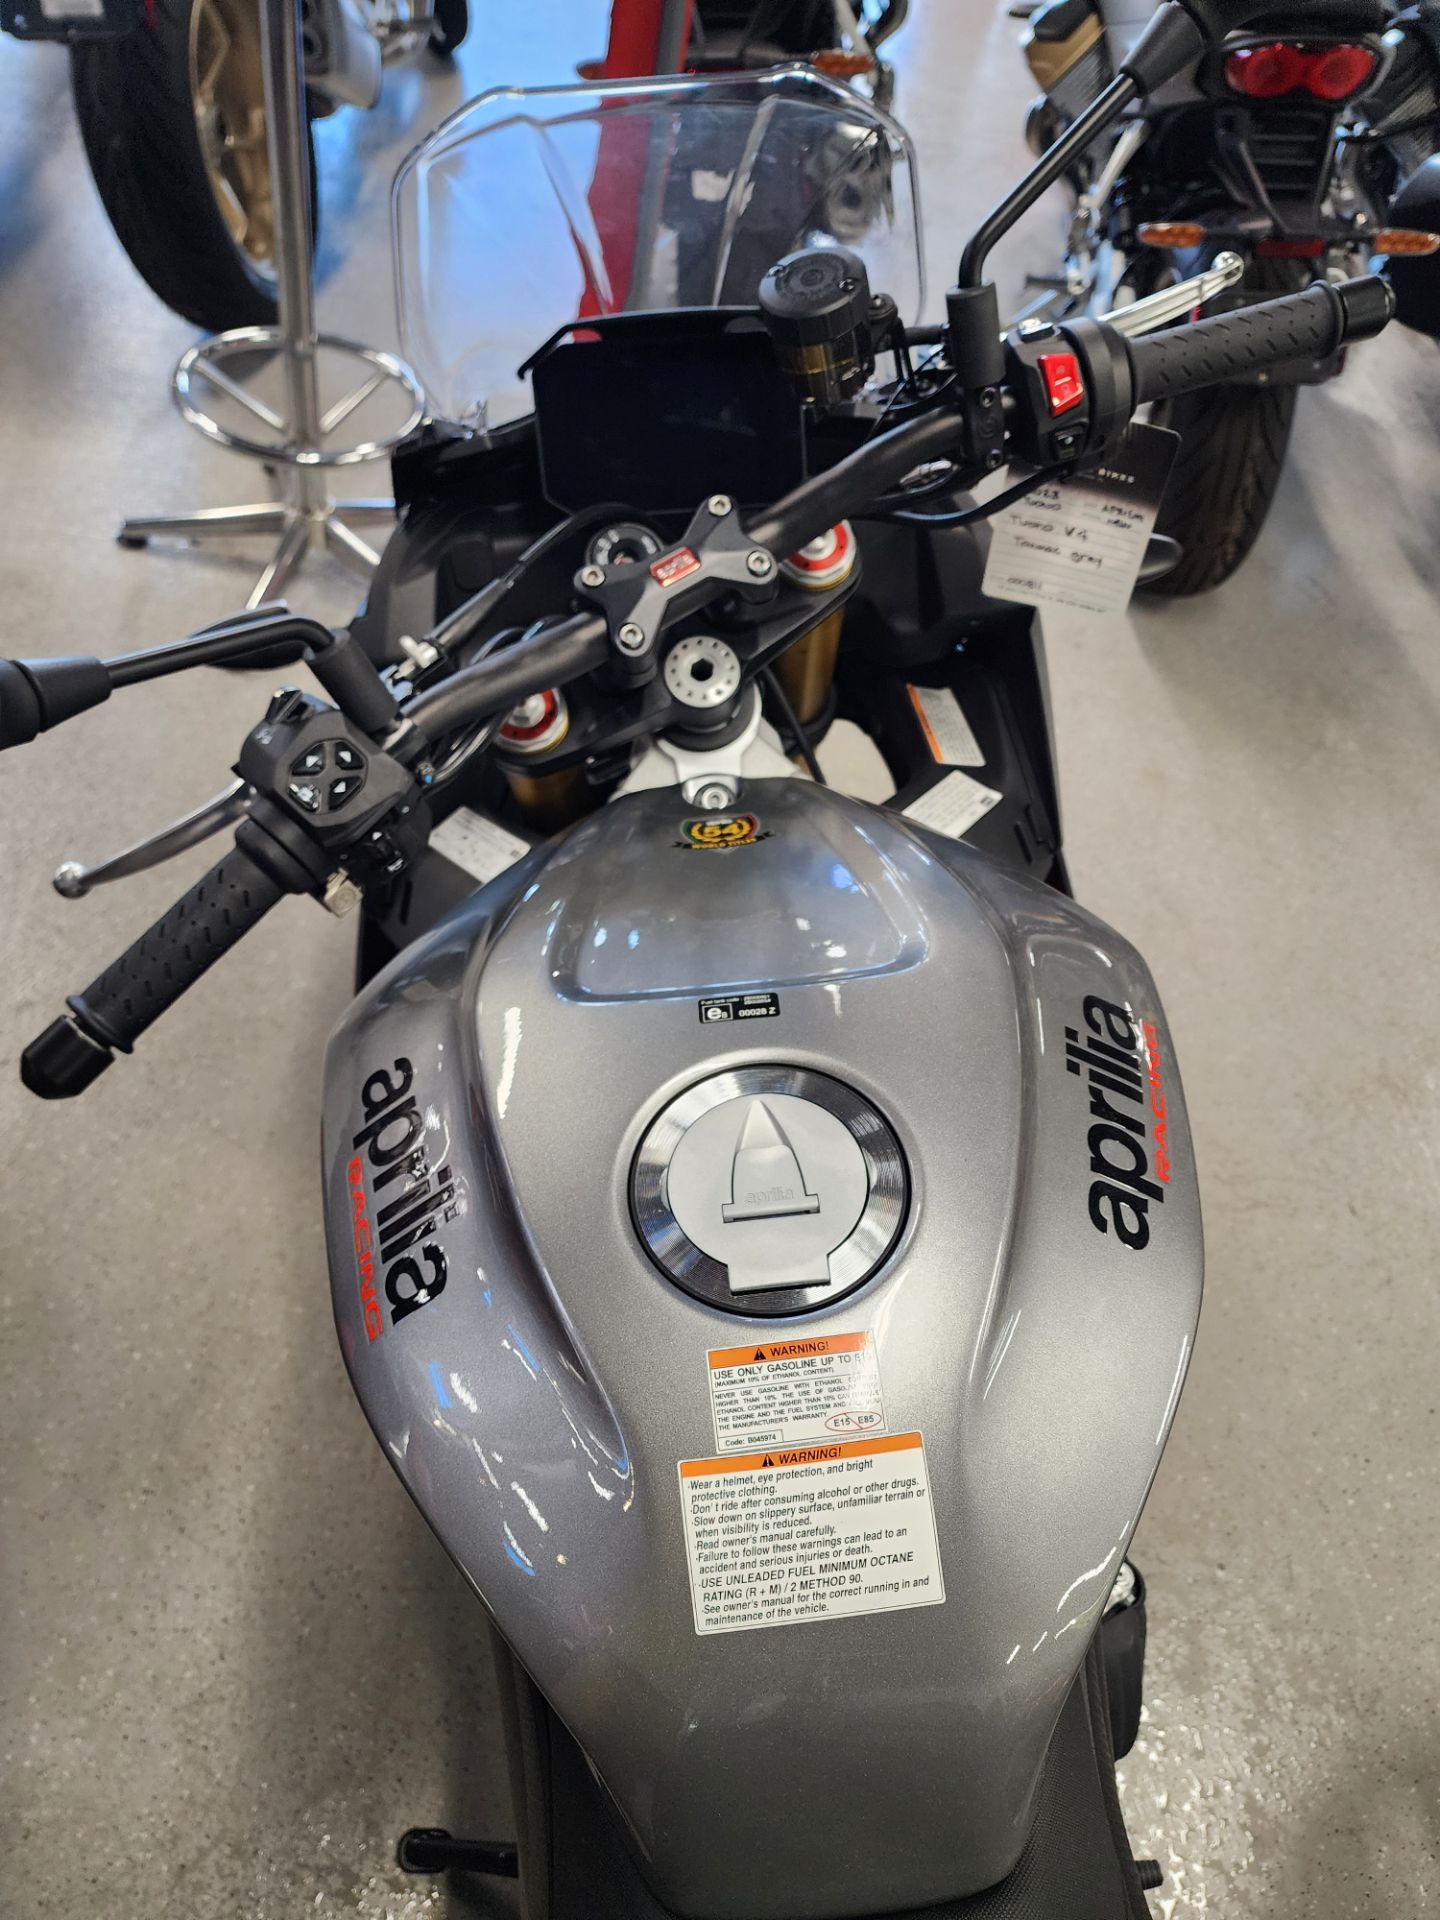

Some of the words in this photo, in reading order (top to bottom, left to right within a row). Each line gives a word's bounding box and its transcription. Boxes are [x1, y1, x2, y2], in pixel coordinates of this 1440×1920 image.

[1065, 994, 1164, 1250] aprilia
[353, 1056, 459, 1326] aprilia
[347, 1155, 385, 1343] RACING
[770, 1341, 829, 1357] WARNING!
[714, 1369, 734, 1380] USE
[737, 1365, 763, 1377] ONLY
[767, 1358, 817, 1373] GASOLINE
[820, 1356, 834, 1366] UP
[838, 1354, 852, 1364] TO
[773, 1372, 801, 1380] ETHANOL
[715, 1391, 735, 1400] NEVER
[758, 1385, 789, 1394] GASOLINE
[815, 1378, 842, 1387] ETHANOL
[716, 1399, 739, 1407] HIGHER
[717, 1407, 745, 1415] ETHANOL
[748, 1402, 776, 1411] CONTENT
[732, 1413, 755, 1421] ENGINE
[788, 1406, 803, 1414] FUEL
[806, 1403, 831, 1412] SYSTEM
[834, 1418, 851, 1428] E15
[858, 1415, 875, 1424] E85
[725, 1439, 745, 1447] Code:
[748, 1434, 776, 1444] B045974
[778, 1447, 842, 1465] WARNING!
[723, 1475, 756, 1487] helmet,
[758, 1474, 773, 1485] eye
[776, 1467, 825, 1481] protection,
[827, 1463, 844, 1475] and
[846, 1458, 873, 1473] bright
[692, 1489, 736, 1505] protective
[738, 1485, 778, 1498] clothing.
[718, 1513, 742, 1524] down
[746, 1512, 757, 1521] on
[760, 1507, 796, 1520] slippery
[799, 1501, 835, 1514] surface,
[837, 1494, 882, 1509] unfamiliar
[885, 1489, 914, 1502] terrain
[917, 1488, 926, 1498] or
[722, 1500, 738, 1511] ride
[741, 1498, 761, 1509] after
[764, 1491, 815, 1506] consuming
[817, 1485, 851, 1499] alcohol
[853, 1486, 863, 1495] or
[865, 1481, 889, 1493] other
[891, 1477, 919, 1490] drugs.
[695, 1528, 719, 1539] when
[722, 1523, 760, 1536] visibility
[762, 1521, 770, 1531] is
[773, 1516, 812, 1529] reduced.
[722, 1535, 758, 1548] owner's
[760, 1530, 793, 1543] manual
[796, 1525, 837, 1539] carefully.
[731, 1550, 740, 1559] to
[743, 1546, 770, 1558] follow
[772, 1543, 797, 1554] these
[800, 1538, 842, 1550] warnings
[844, 1535, 861, 1545] can
[863, 1530, 882, 1542] lead
[885, 1529, 894, 1539] to
[896, 1528, 907, 1537] an
[700, 1562, 738, 1575] accident
[740, 1560, 757, 1570] and
[760, 1555, 793, 1568] serious
[796, 1551, 830, 1565] injuries
[832, 1549, 842, 1558] or
[845, 1543, 873, 1556] death.
[725, 1569, 785, 1586] UNLEADED
[788, 1565, 816, 1578] FUEL
[819, 1559, 867, 1574] MINIMUM
[870, 1551, 914, 1567] OCTANE
[703, 1588, 743, 1602] RATING
[745, 1587, 757, 1600] (R
[760, 1588, 766, 1596] +
[769, 1583, 782, 1596] M)
[790, 1582, 797, 1592] 2
[800, 1574, 846, 1590] METHOD
[849, 1573, 863, 1584] 90.
[723, 1599, 758, 1612] owner's
[761, 1594, 795, 1608] manual
[797, 1592, 810, 1603] for
[812, 1591, 827, 1601] the
[829, 1587, 862, 1599] correct
[864, 1581, 900, 1594] running
[902, 1579, 910, 1589] in
[912, 1576, 930, 1588] and
[705, 1611, 763, 1626] maintenance
[766, 1608, 775, 1619] of
[778, 1606, 792, 1617] the
[794, 1602, 829, 1615] vehicle.
